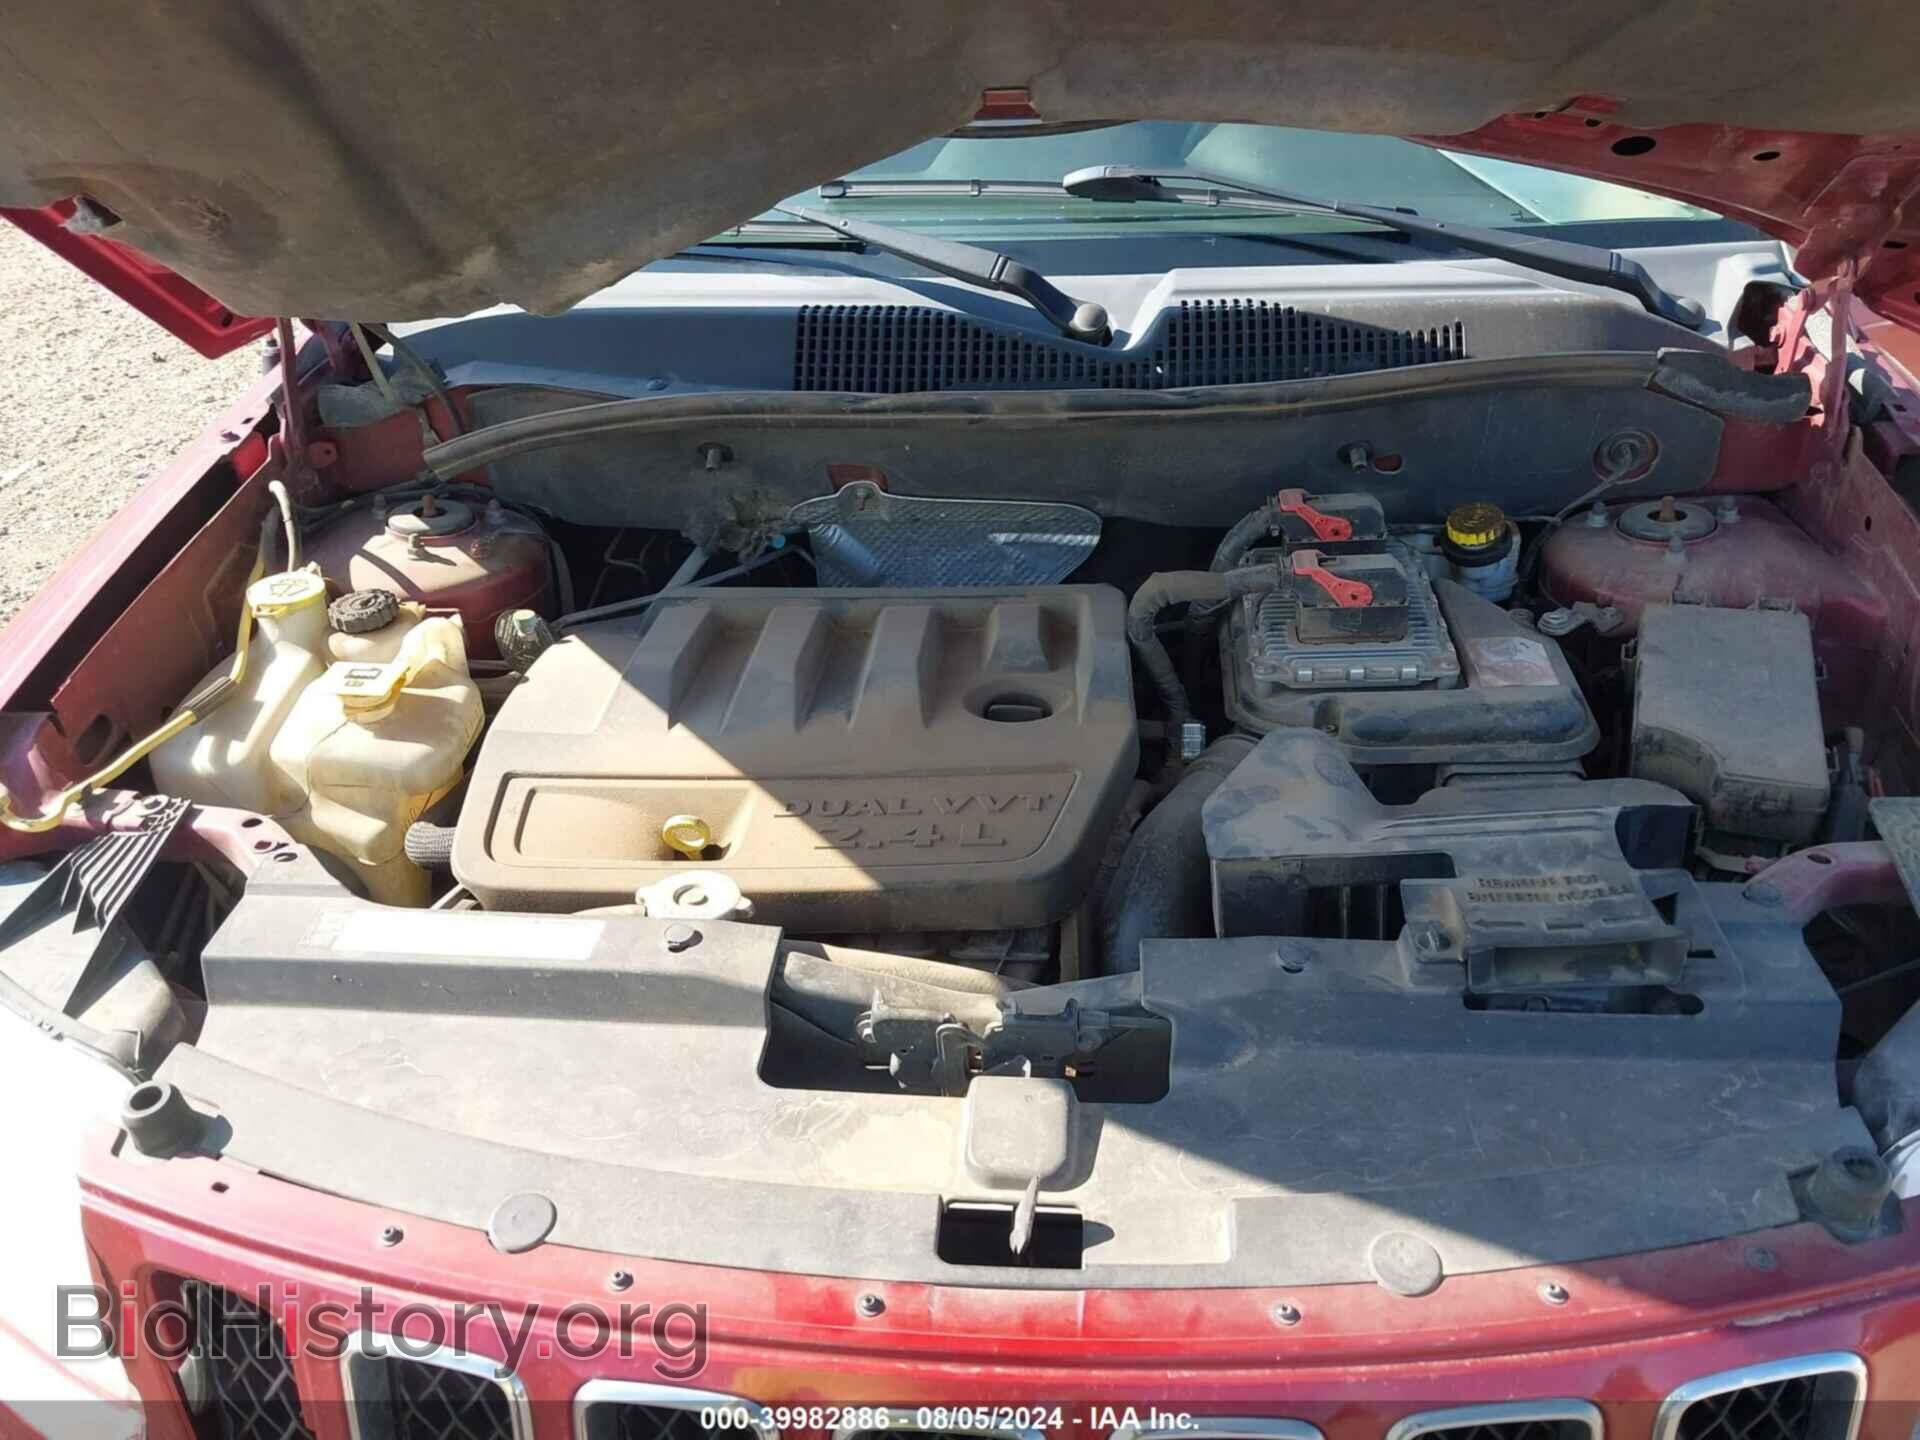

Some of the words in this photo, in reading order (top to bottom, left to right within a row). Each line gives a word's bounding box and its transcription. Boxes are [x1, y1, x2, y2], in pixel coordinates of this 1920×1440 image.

[774, 797, 923, 818] DUAL
[932, 793, 1054, 816] VVT
[814, 823, 1008, 850] 2.4L
